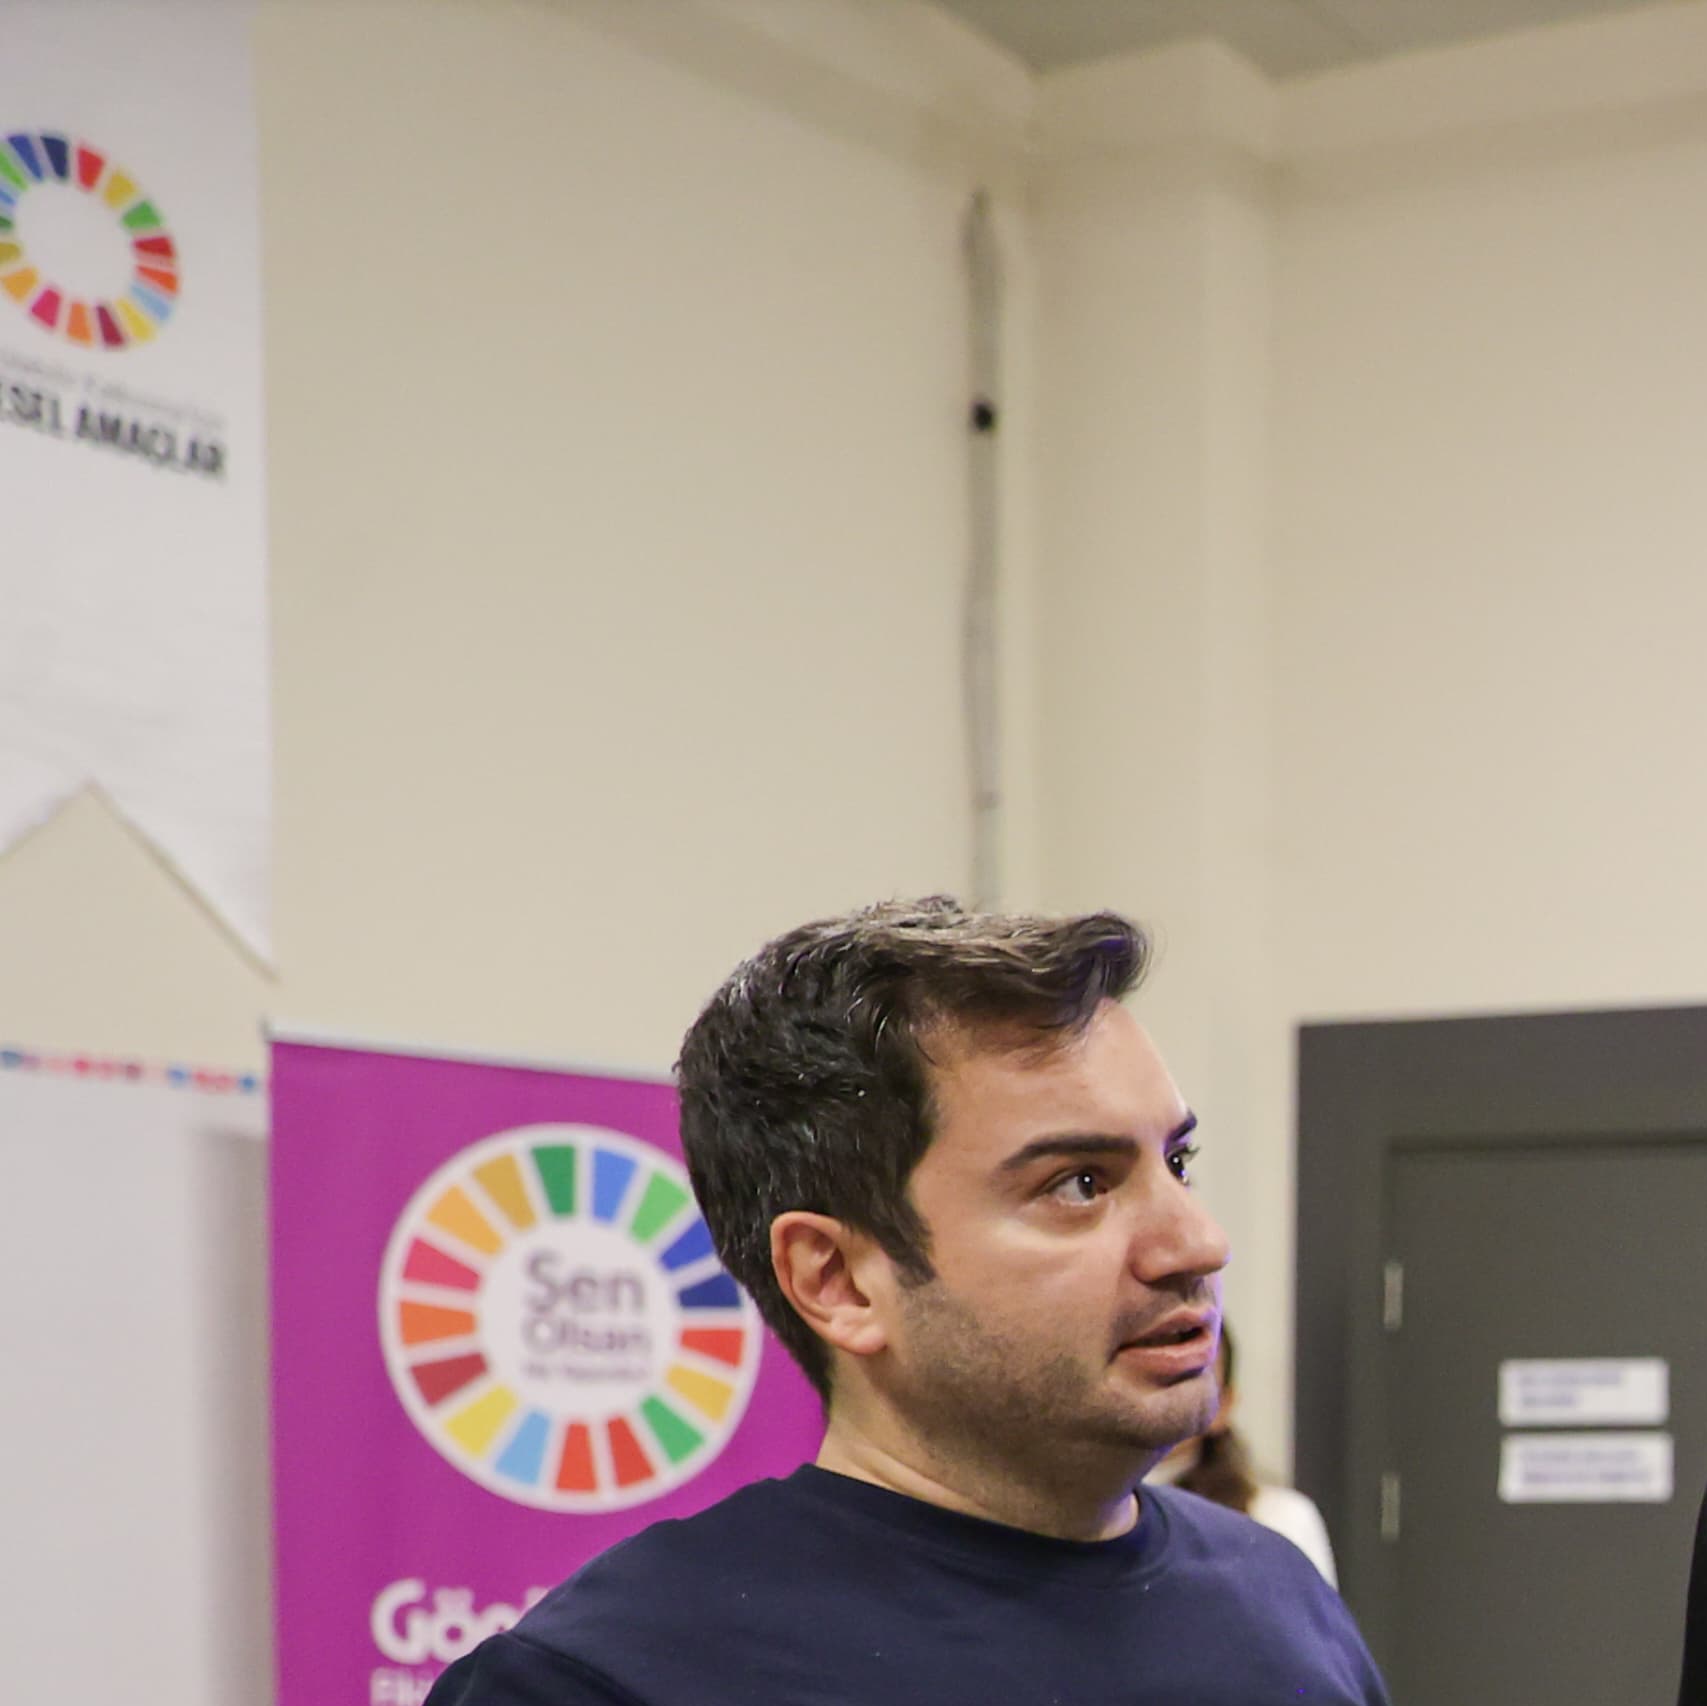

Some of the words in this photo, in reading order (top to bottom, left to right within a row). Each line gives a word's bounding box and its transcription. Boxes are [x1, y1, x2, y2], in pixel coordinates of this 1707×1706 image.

[0, 378, 62, 438] SEL
[525, 1247, 646, 1314] Sen
[523, 1316, 652, 1353] Olsan
